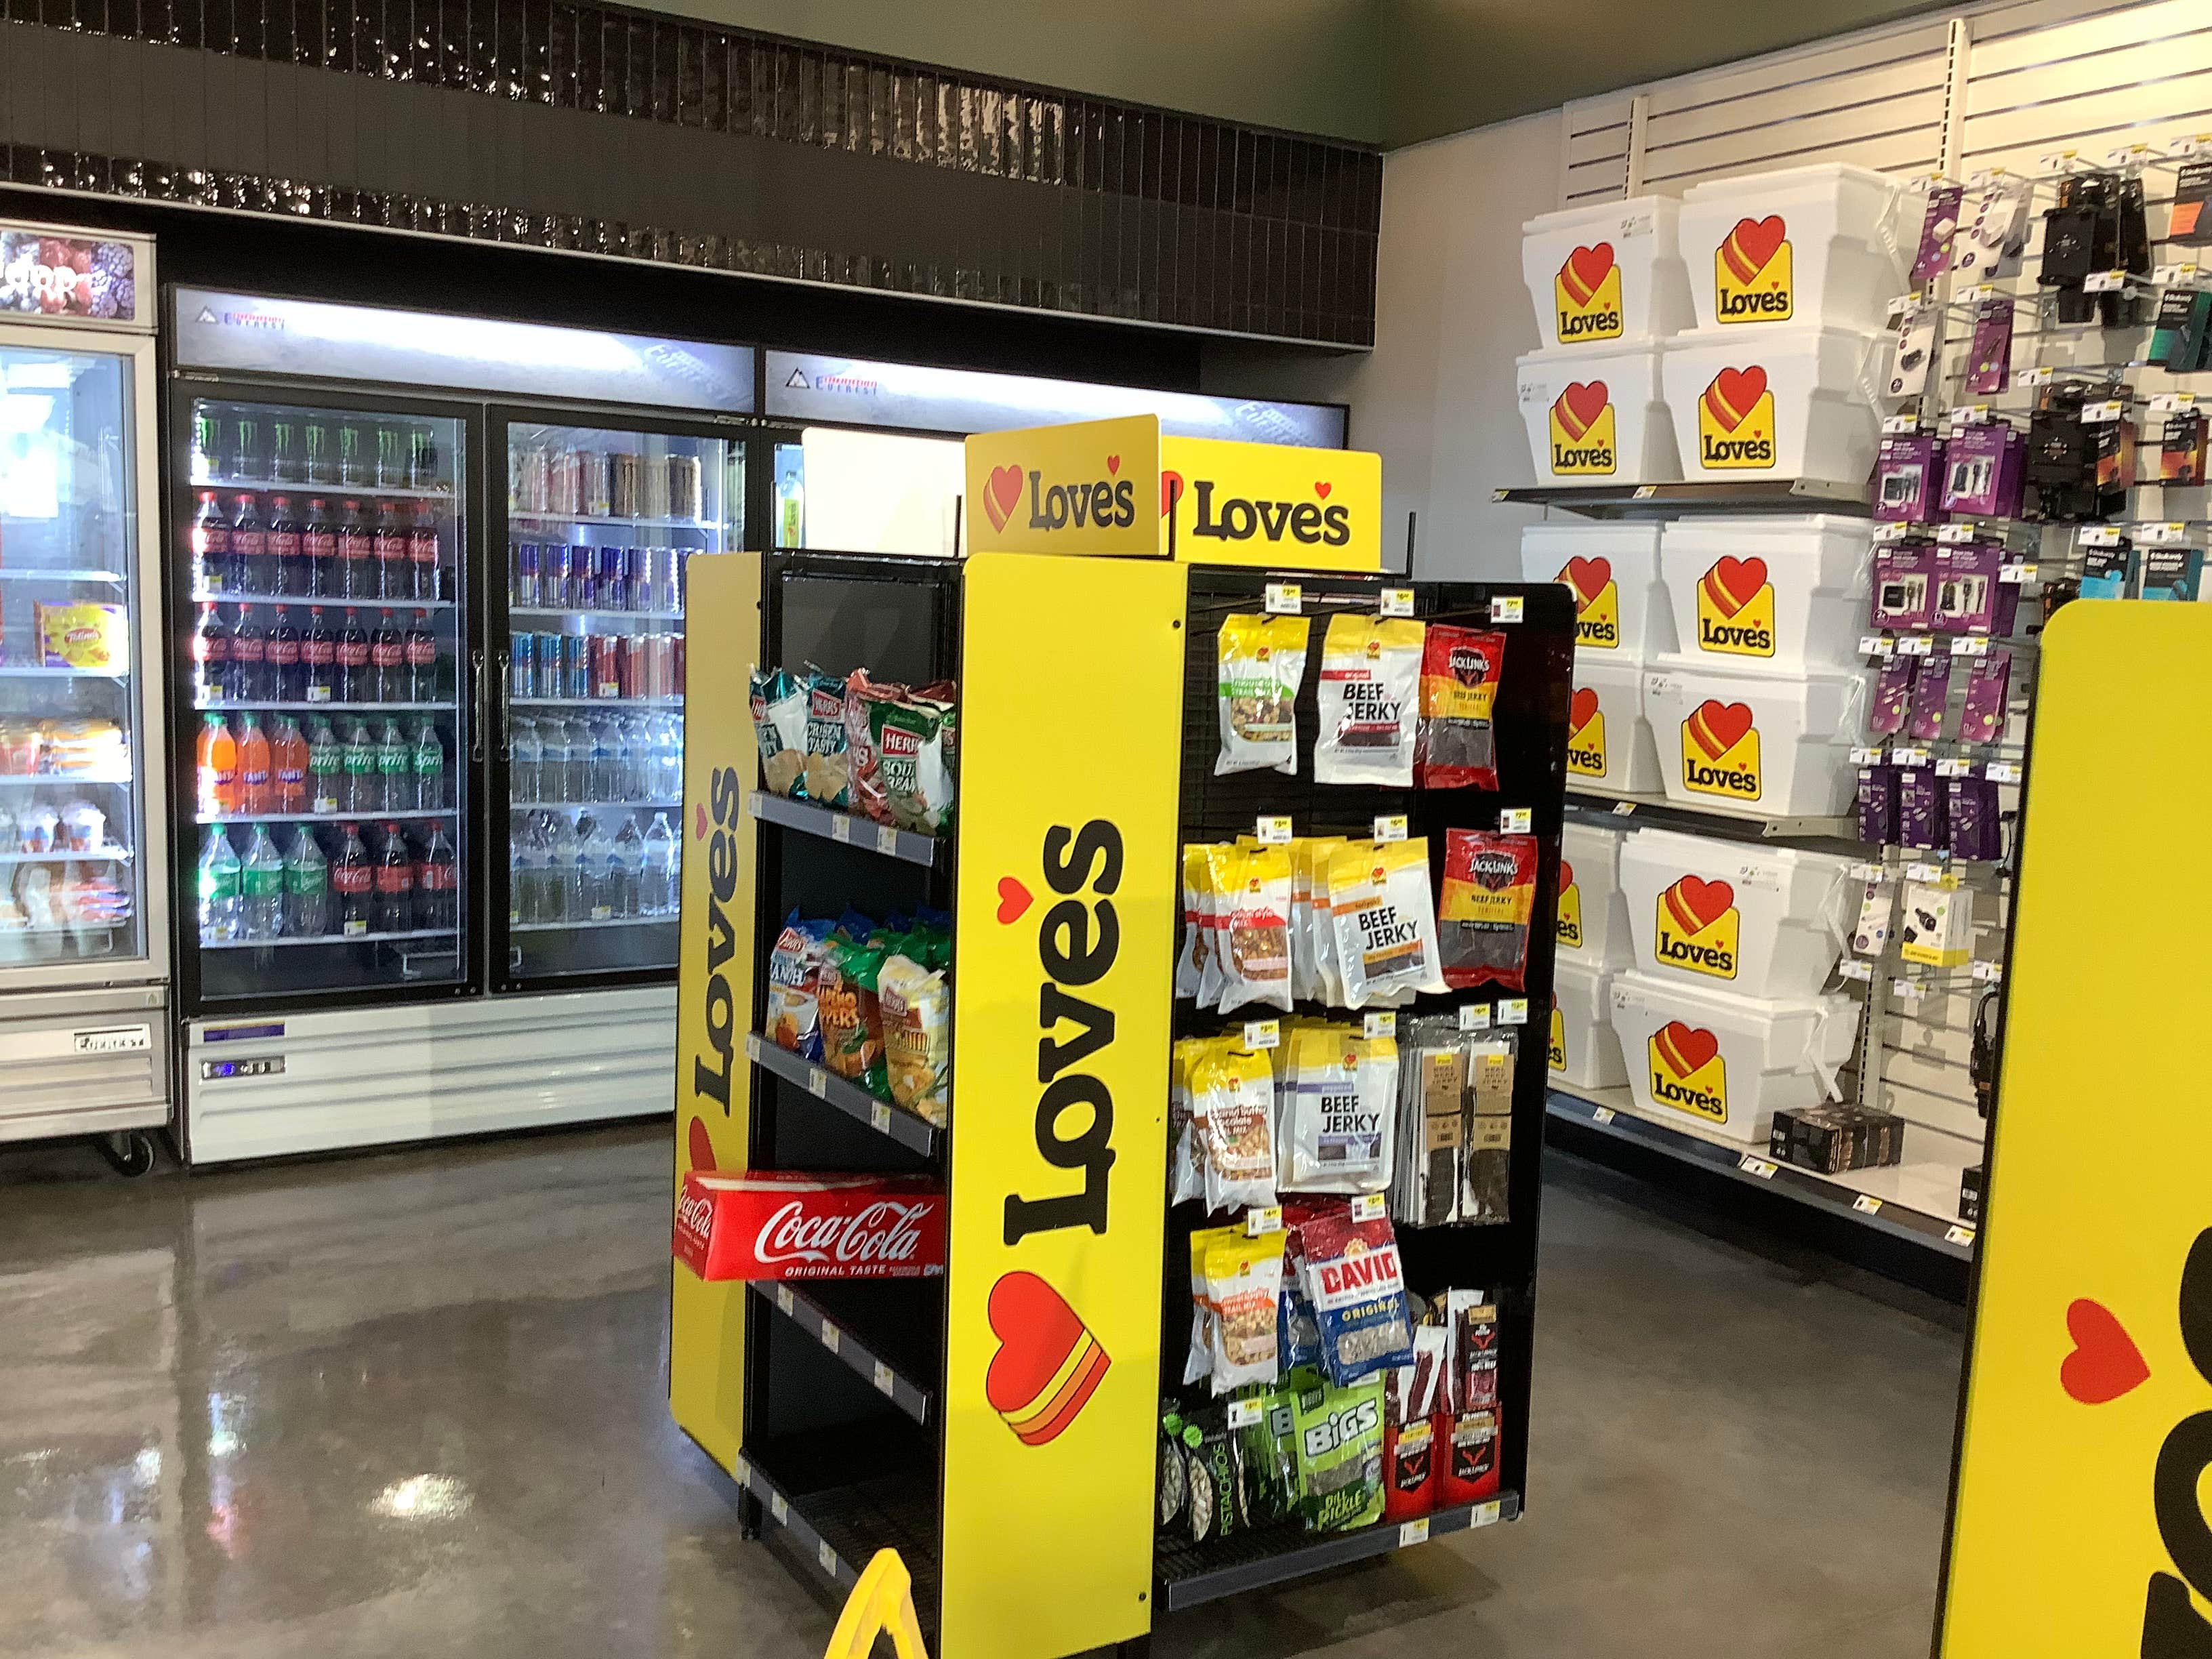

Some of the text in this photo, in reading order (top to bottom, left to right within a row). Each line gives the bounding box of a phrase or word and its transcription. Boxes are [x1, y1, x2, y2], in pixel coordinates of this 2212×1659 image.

[1343, 682, 1384, 701] BEEF
[1344, 702, 1401, 720] JERKY
[1358, 905, 1397, 931] BEEF
[1366, 919, 1418, 950] JERKY
[1321, 1094, 1359, 1113] BEEF
[1322, 1112, 1381, 1133] JERKY
[753, 1200, 935, 1263] Coca-Cola
[784, 1265, 846, 1277] ORIGINAL
[849, 1264, 885, 1276] TASTE
[1320, 1251, 1398, 1295] DAVID
[1341, 1297, 1399, 1322] ORIGINAL
